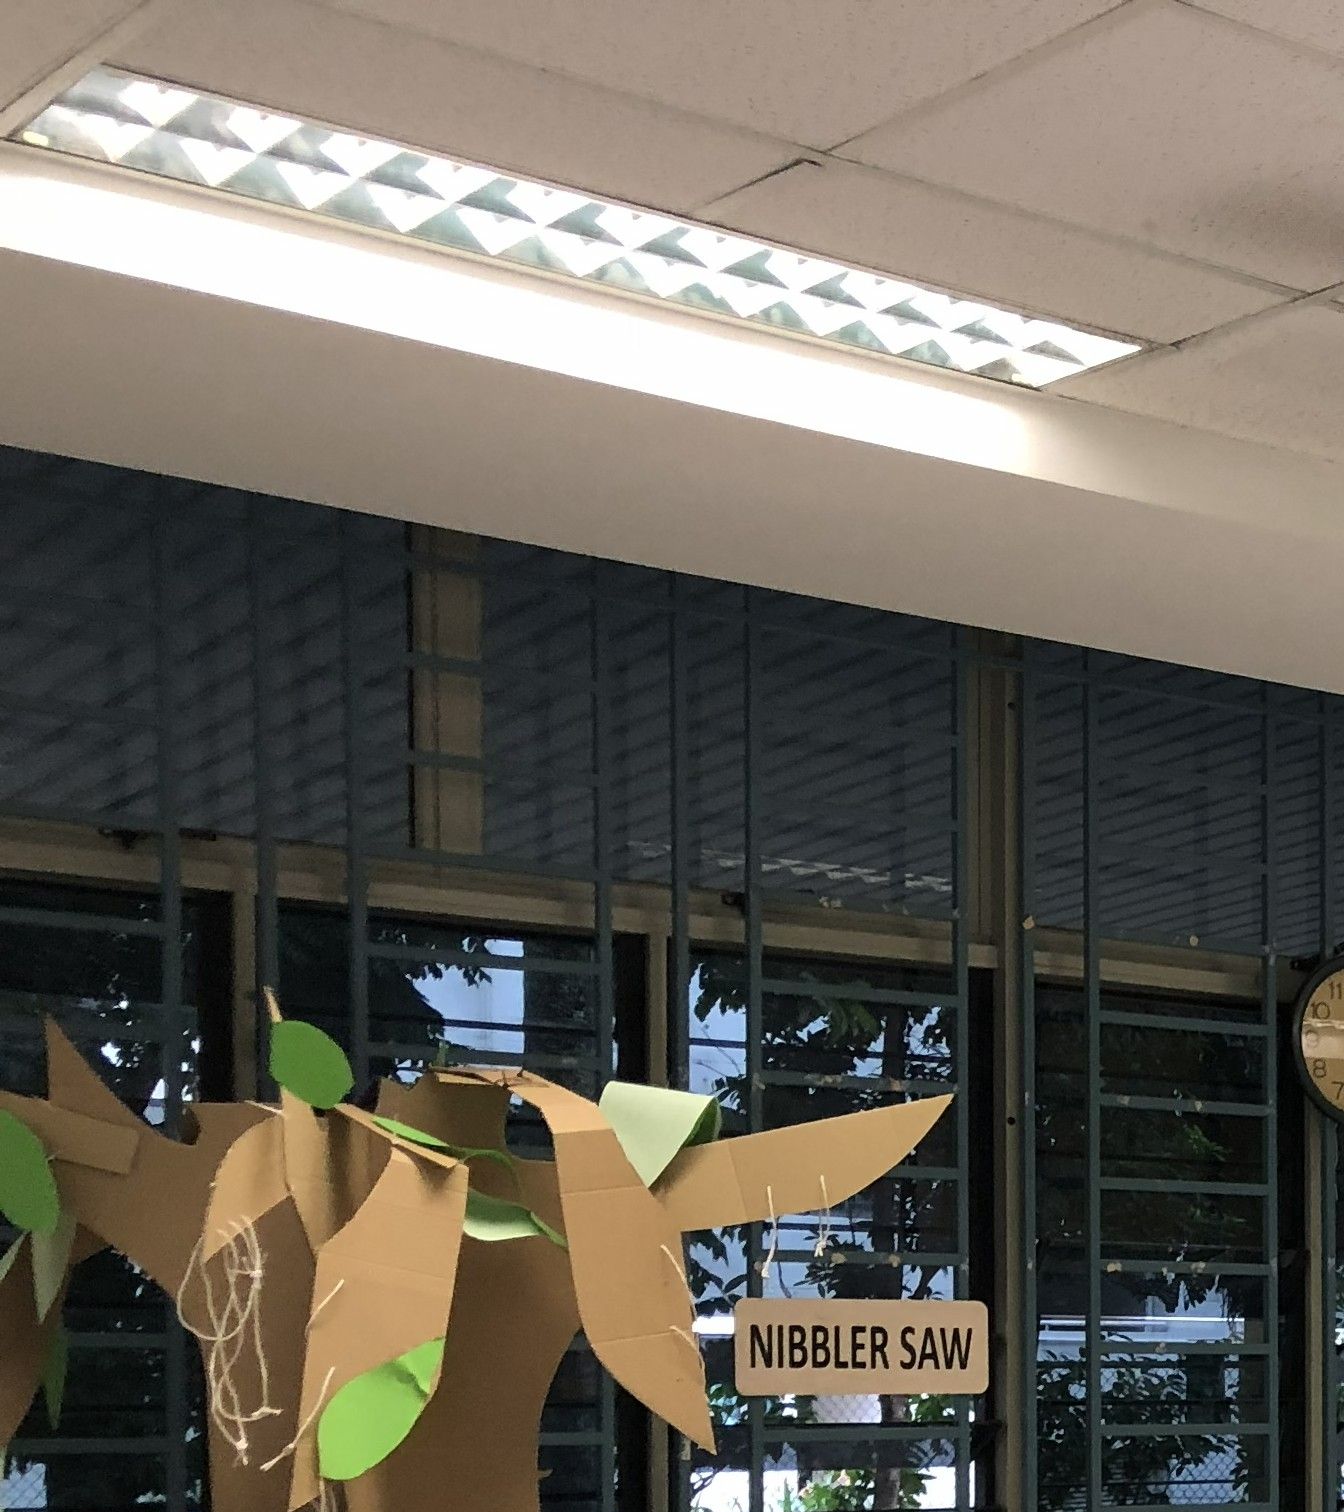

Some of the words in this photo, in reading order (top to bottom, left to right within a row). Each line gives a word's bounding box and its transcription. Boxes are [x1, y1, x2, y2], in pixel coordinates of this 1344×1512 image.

[1328, 981, 1343, 1000] 11
[1310, 1001, 1331, 1020] 10
[1312, 1059, 1327, 1078] 8
[1331, 1081, 1344, 1100] 7
[749, 1324, 890, 1370] NIBBLER
[900, 1326, 973, 1371] SAW
